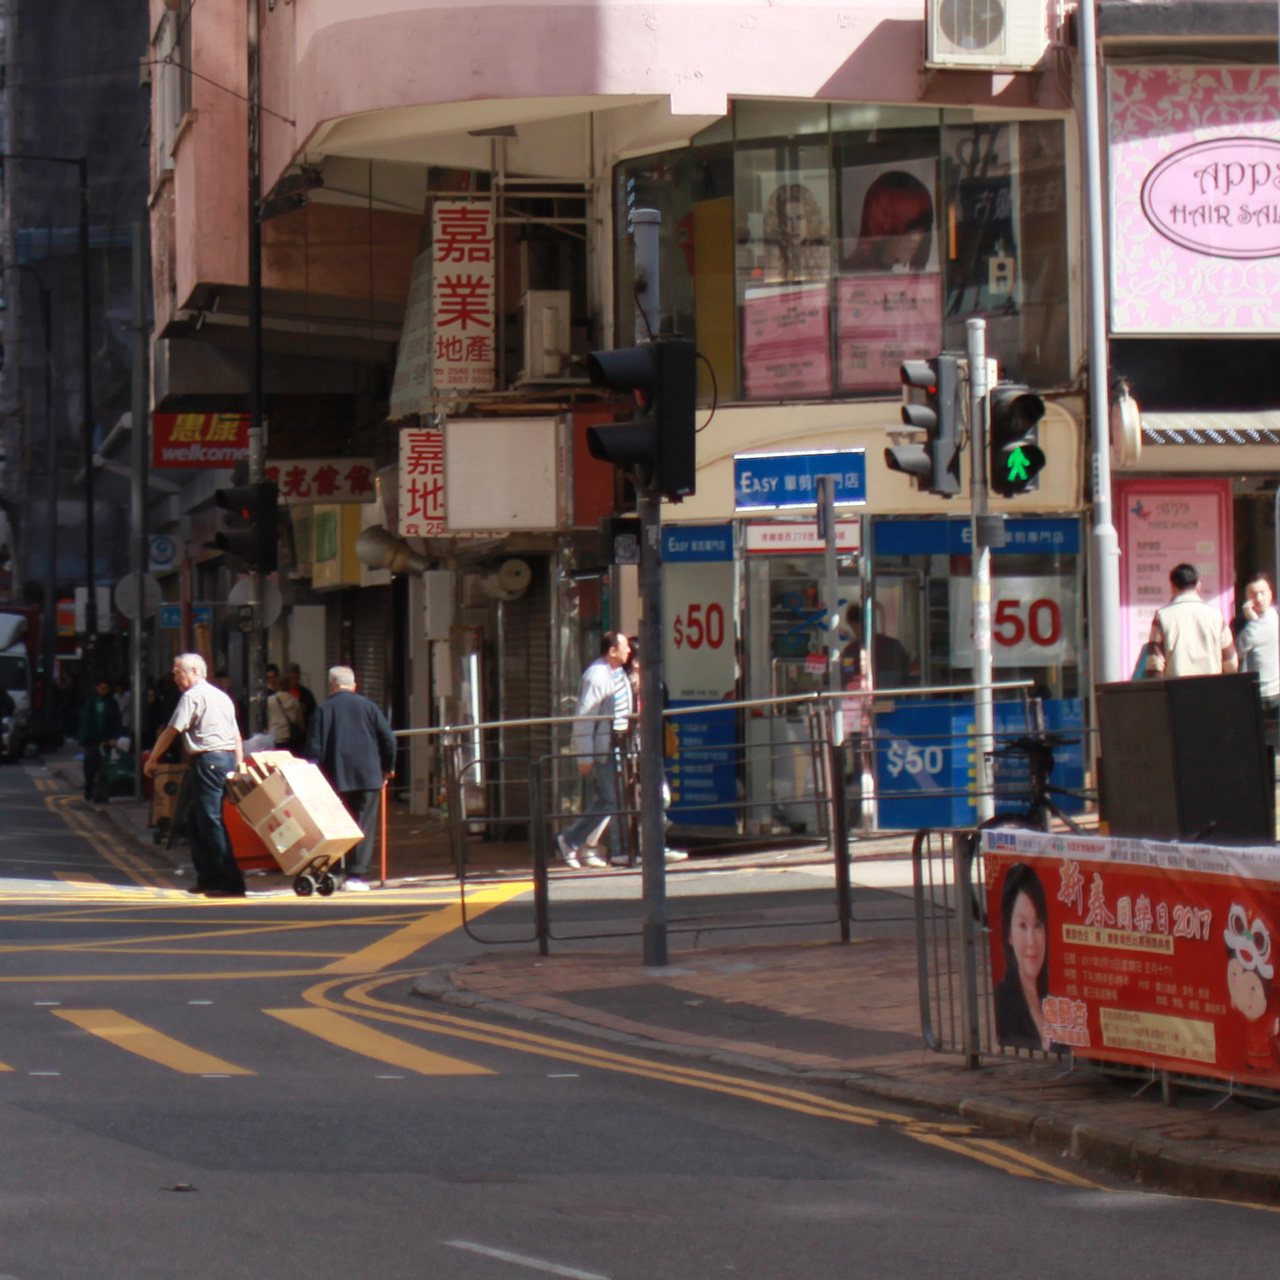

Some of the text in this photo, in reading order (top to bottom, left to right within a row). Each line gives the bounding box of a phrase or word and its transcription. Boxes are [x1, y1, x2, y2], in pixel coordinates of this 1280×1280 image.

[1170, 204, 1280, 228] HAIR SAL
[435, 206, 492, 331] 嘉業
[436, 335, 492, 363] 地產
[169, 413, 241, 441] 惠康
[161, 443, 251, 462] wellcome
[407, 431, 444, 476] 嘉
[407, 478, 445, 520] 地
[739, 471, 779, 494] EASY
[673, 602, 725, 650] $50
[971, 598, 1062, 648] 50
[886, 745, 944, 778] $50
